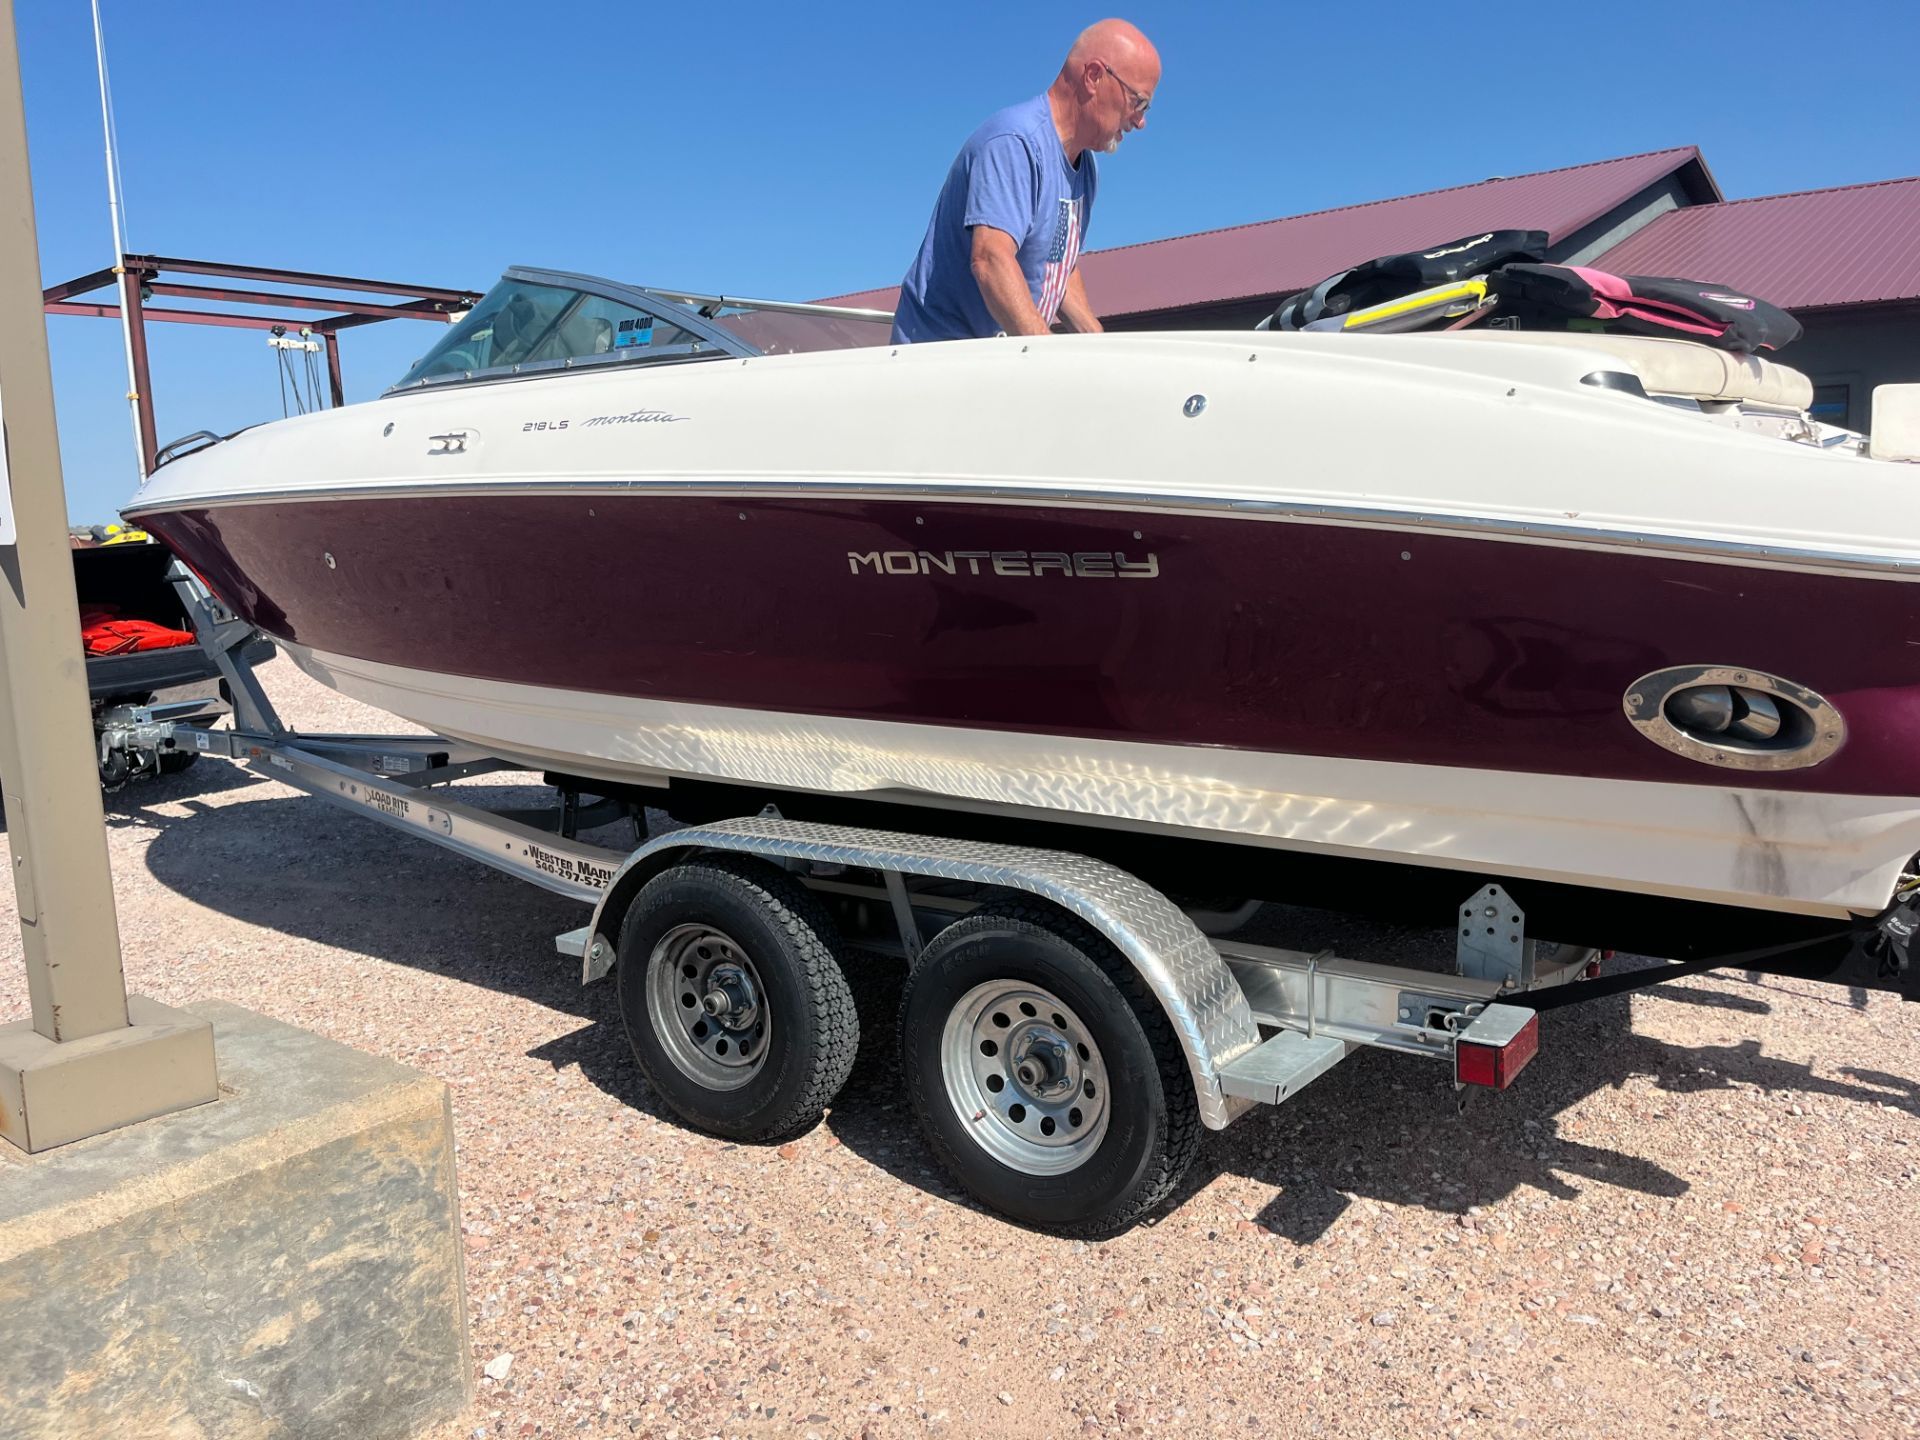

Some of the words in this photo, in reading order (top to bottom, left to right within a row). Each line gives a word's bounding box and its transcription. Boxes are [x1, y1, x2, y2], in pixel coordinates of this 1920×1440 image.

[847, 551, 1160, 579] MONTEREY
[371, 790, 391, 806] LOAD
[391, 796, 409, 813] RITE
